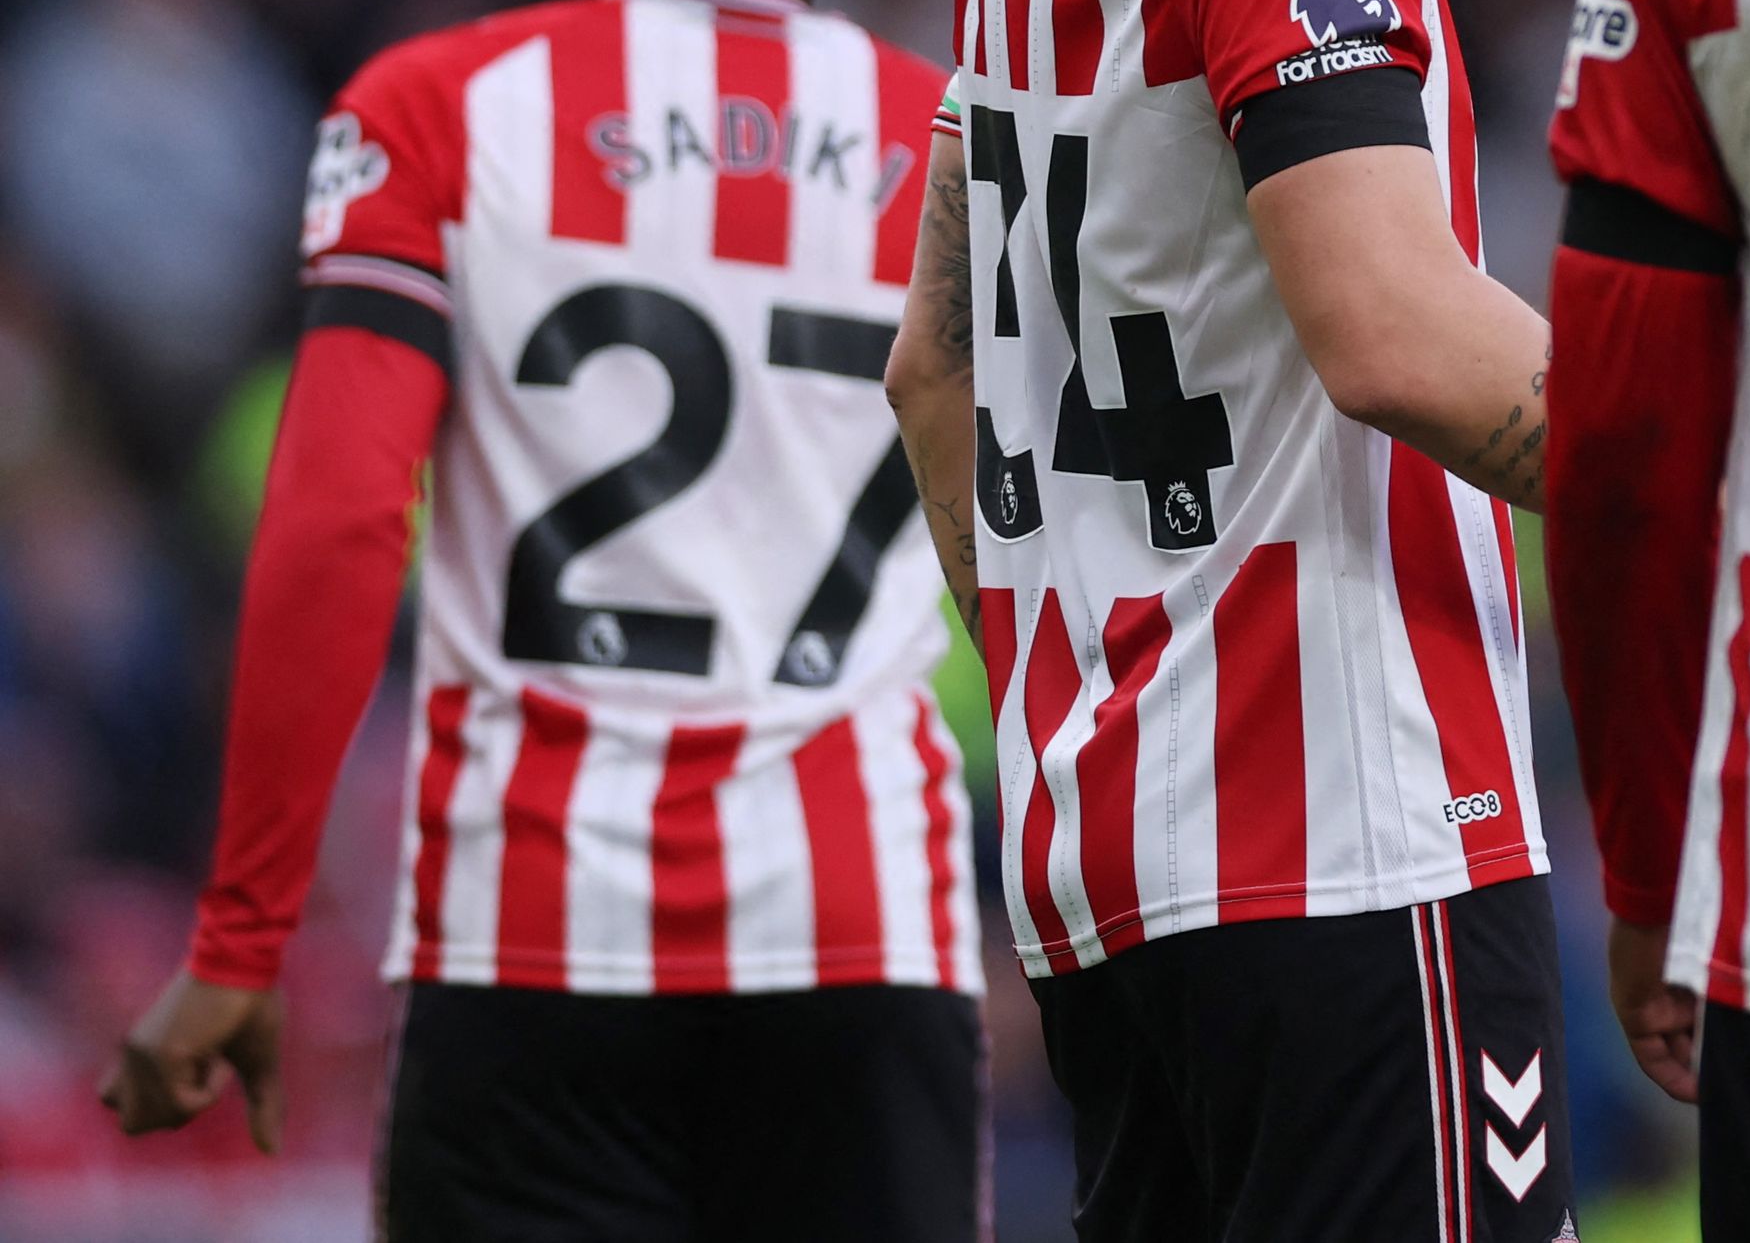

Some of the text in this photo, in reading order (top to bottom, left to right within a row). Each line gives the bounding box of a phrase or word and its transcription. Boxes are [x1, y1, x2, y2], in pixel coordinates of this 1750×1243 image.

[1320, 44, 1394, 74] racism
[588, 98, 915, 210] SADIKI
[503, 282, 918, 687] 27
[1443, 794, 1498, 823] ECO8
